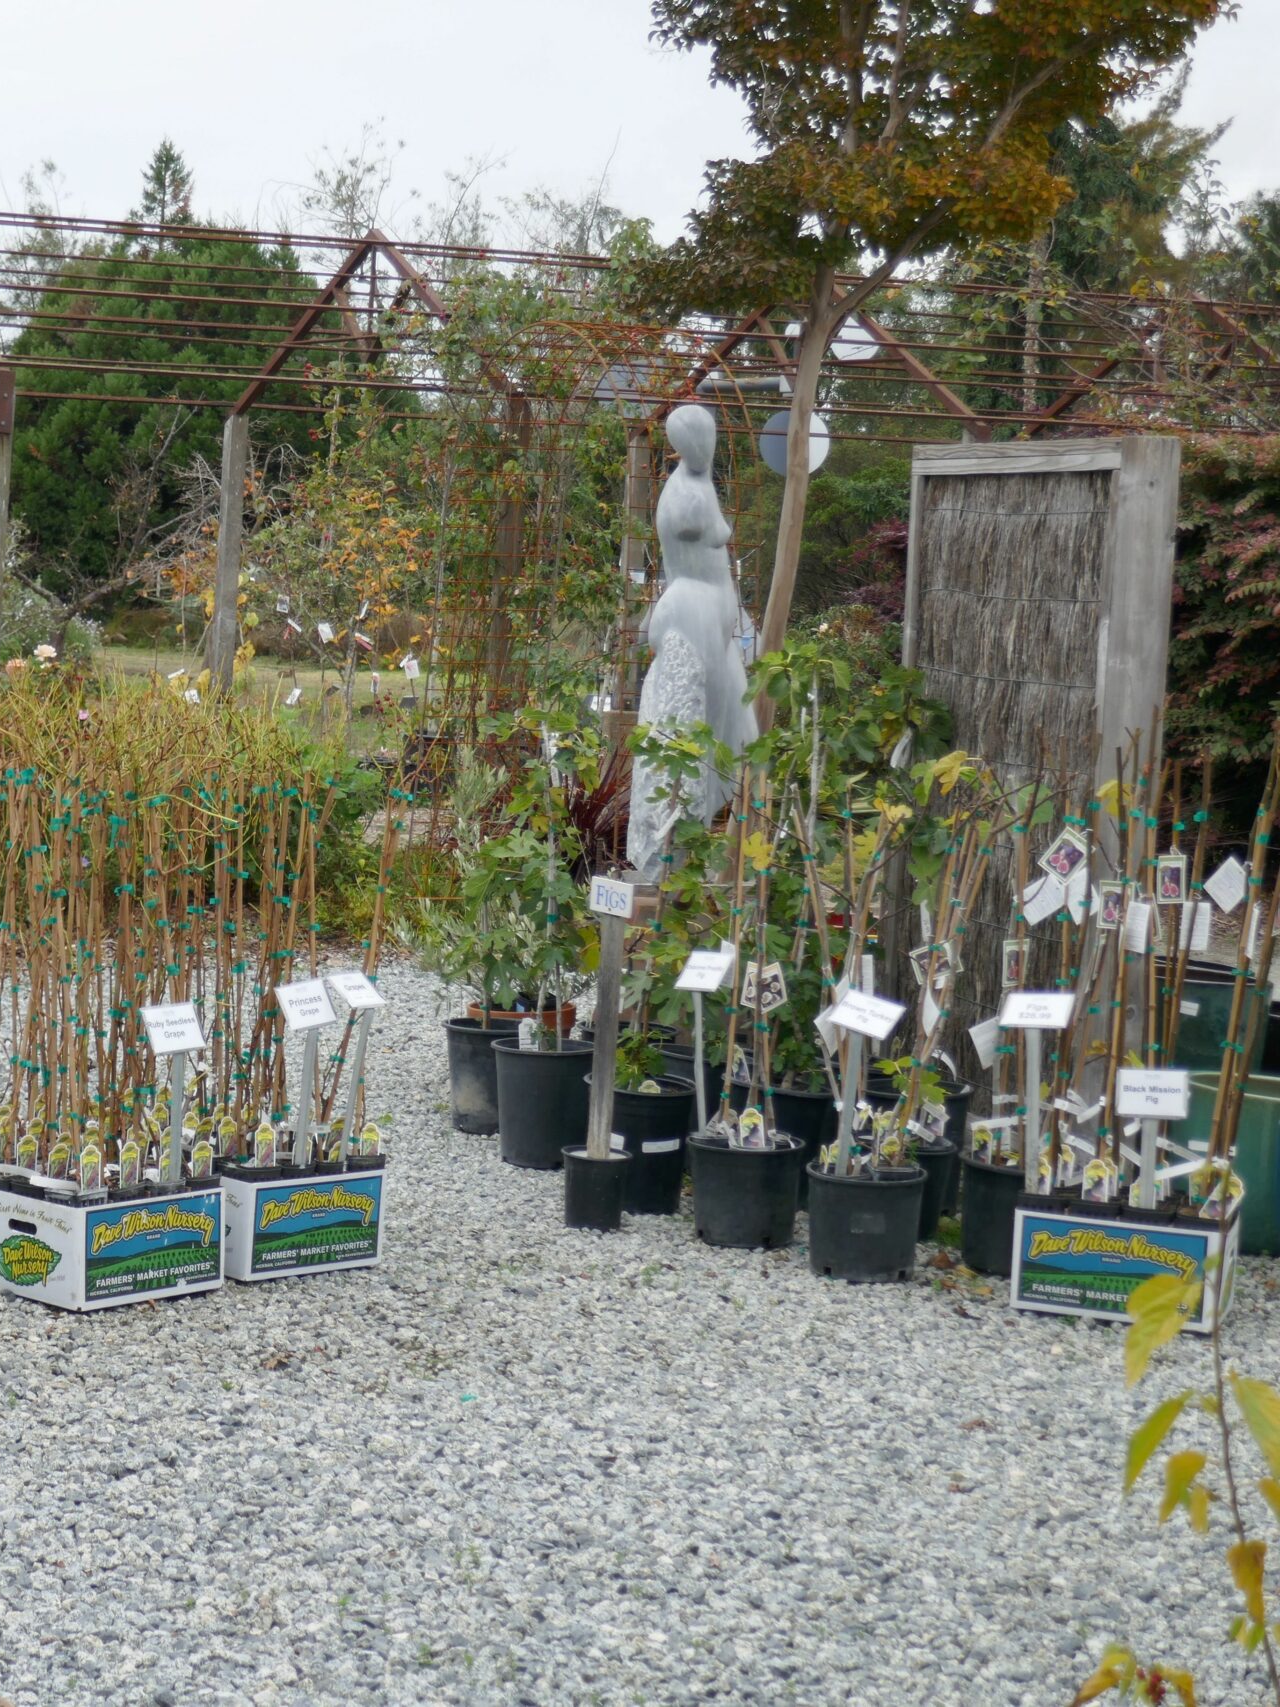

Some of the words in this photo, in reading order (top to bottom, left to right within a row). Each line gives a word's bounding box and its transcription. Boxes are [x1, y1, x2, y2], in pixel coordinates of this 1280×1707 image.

[596, 885, 627, 910] FIGS
[288, 996, 322, 1007] Princess
[300, 1007, 320, 1017] Grape
[146, 1020, 164, 1029] Ruby
[166, 1017, 195, 1026] Seedless
[164, 1031, 185, 1039] Grape
[1123, 1085, 1146, 1093] Black
[1148, 1086, 1182, 1094] Mission
[1145, 1095, 1159, 1104] Fig
[260, 1200, 290, 1230] Dave
[290, 1189, 331, 1218] Wilson
[330, 1185, 375, 1226] Nursery
[92, 1222, 122, 1256] Dave
[121, 1209, 164, 1240] Wilson
[164, 1205, 215, 1247] Nursery
[3, 1246, 24, 1263] Dave
[21, 1240, 54, 1261] Wilson
[262, 1249, 298, 1261] FARMERS'
[300, 1245, 330, 1256] MARKET
[1029, 1232, 1071, 1260] Dave
[1070, 1229, 1128, 1256] Wilson
[1126, 1234, 1198, 1281] Nursery
[12, 1256, 49, 1287] Nursery
[96, 1273, 135, 1288] FARMERS'
[137, 1268, 169, 1281] MARKET
[1032, 1283, 1084, 1297] FARMERS'
[1085, 1290, 1129, 1303] MARKET
